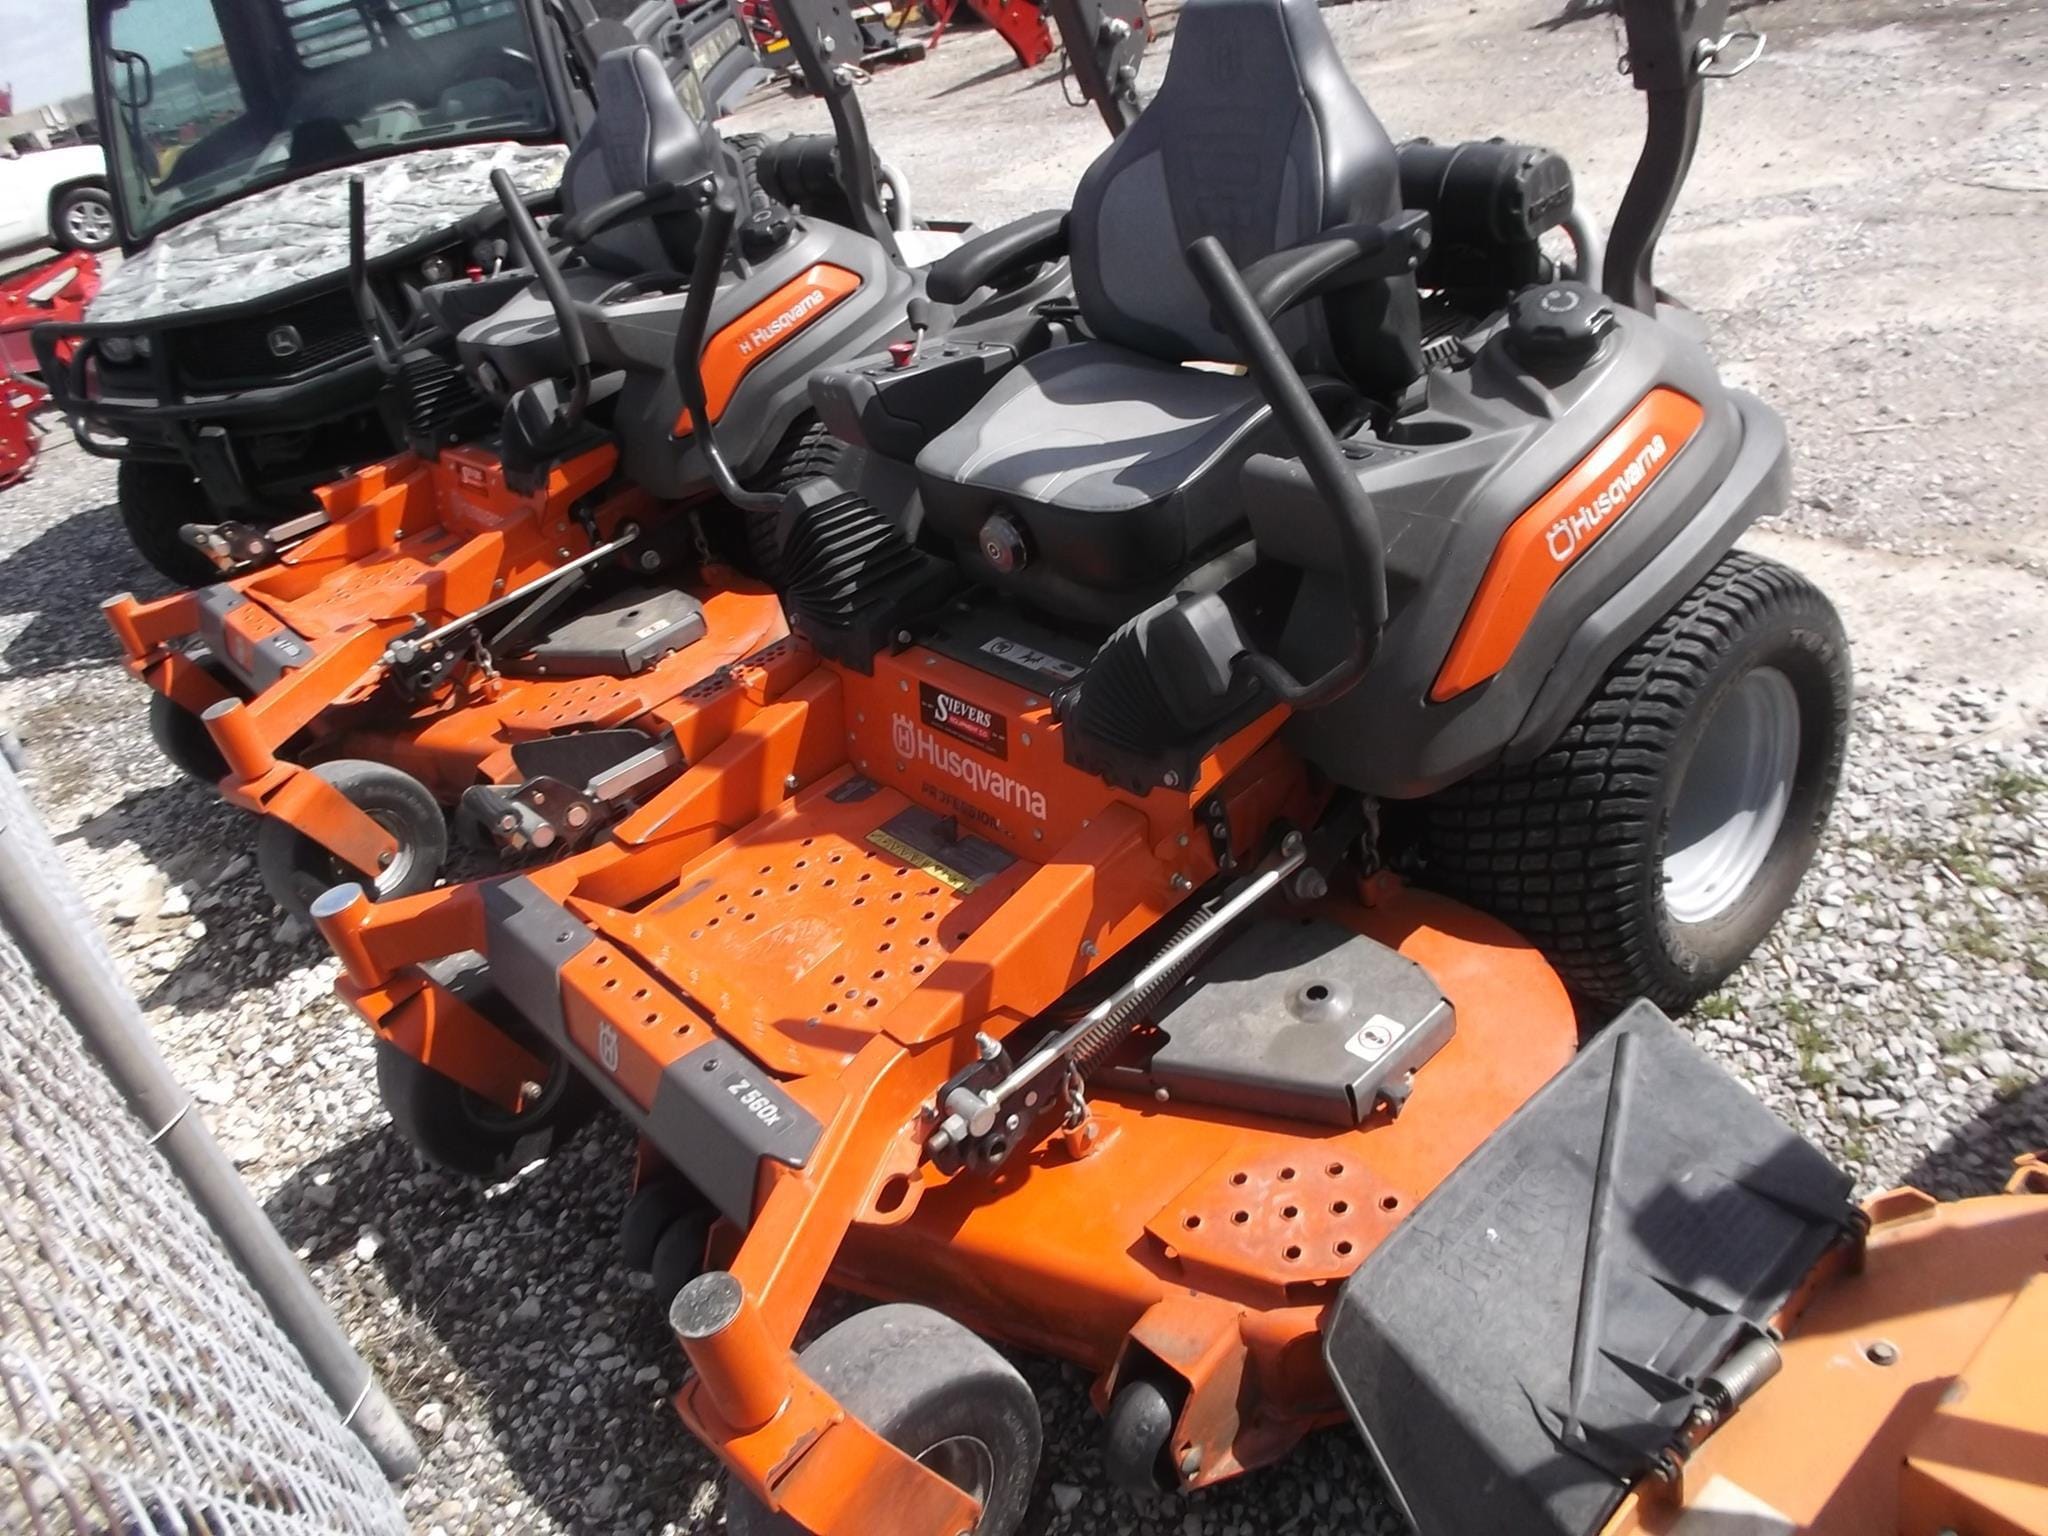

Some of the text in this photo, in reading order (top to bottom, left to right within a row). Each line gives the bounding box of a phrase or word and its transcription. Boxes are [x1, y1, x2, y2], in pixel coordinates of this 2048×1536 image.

[750, 289, 825, 347] Husqvarna
[1569, 434, 1667, 540] Husqvarna
[935, 693, 992, 728] SIEVERS
[917, 729, 1047, 820] Husqvarna
[727, 1078, 751, 1095] Z
